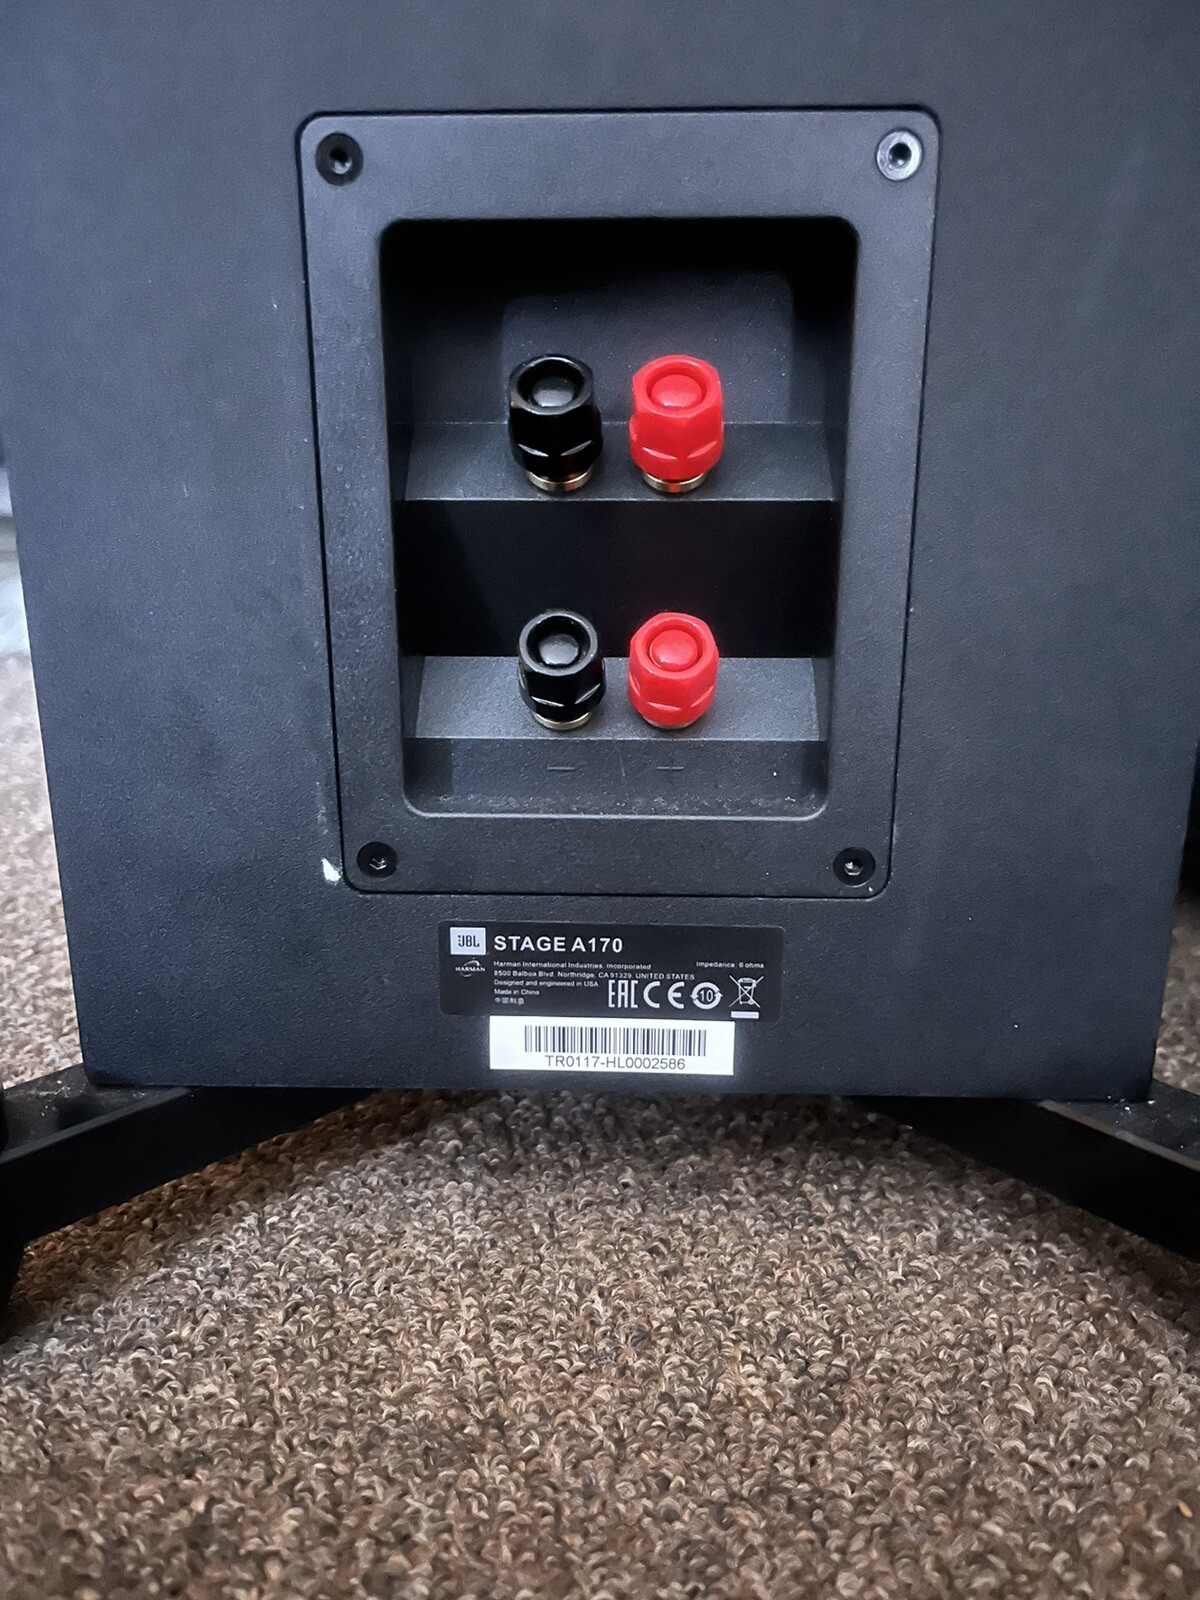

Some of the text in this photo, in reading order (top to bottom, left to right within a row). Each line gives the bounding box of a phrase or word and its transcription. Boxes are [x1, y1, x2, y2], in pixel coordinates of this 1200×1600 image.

[457, 934, 480, 948] JBL
[493, 936, 623, 953] STAGE A170
[745, 961, 764, 969] ohms
[493, 979, 524, 987] Designed
[598, 971, 609, 979] CA
[635, 972, 665, 980] UNITED
[666, 973, 695, 981] STATES
[521, 988, 540, 996] China
[643, 980, 685, 1009] CE
[699, 989, 714, 1003] 10
[545, 1055, 686, 1071] TR0117-HL0002586
